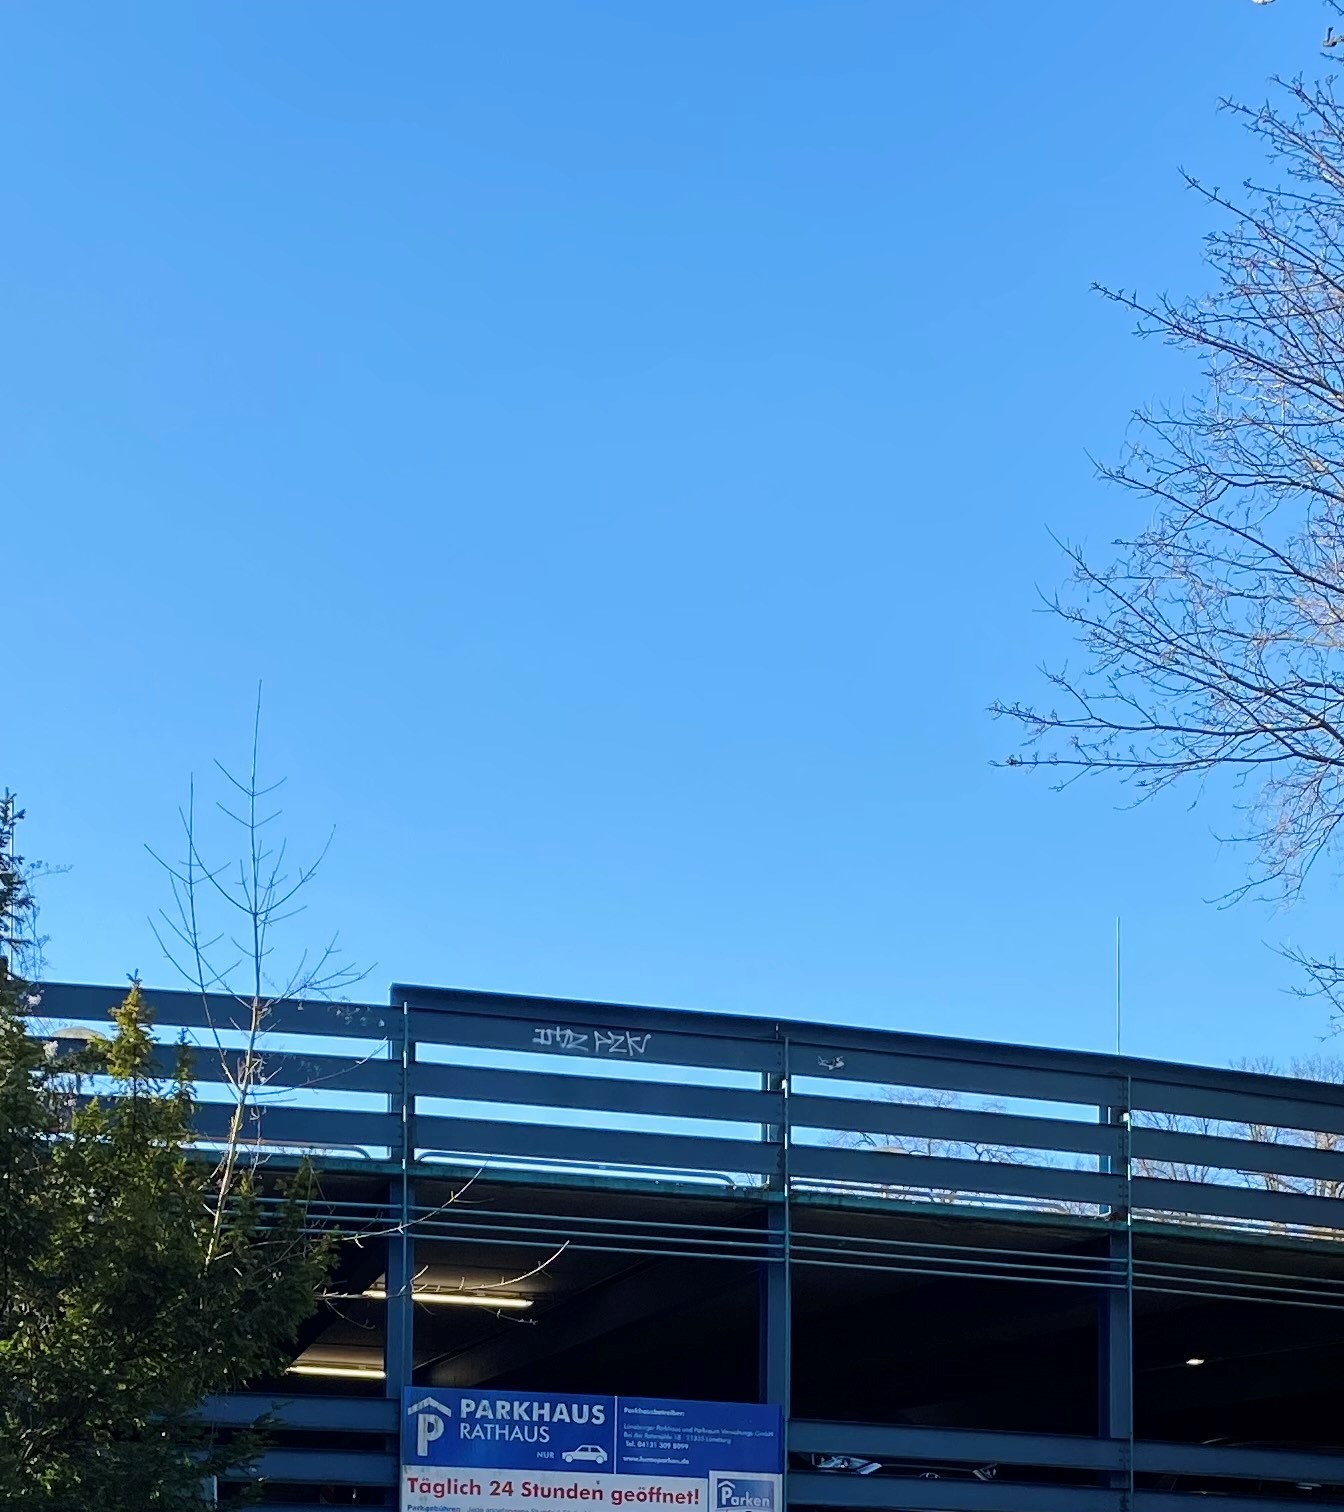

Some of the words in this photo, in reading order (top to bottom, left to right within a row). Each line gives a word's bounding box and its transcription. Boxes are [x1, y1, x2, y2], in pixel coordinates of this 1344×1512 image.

[460, 1398, 606, 1425] PARKHAUS
[459, 1422, 550, 1443] RATHAUS
[536, 1450, 554, 1459] NUR
[407, 1477, 481, 1498] Täglich
[489, 1480, 514, 1496] 24
[521, 1481, 603, 1501] Stunden
[611, 1486, 700, 1506] geöffnet!
[721, 1486, 770, 1507] Parken
